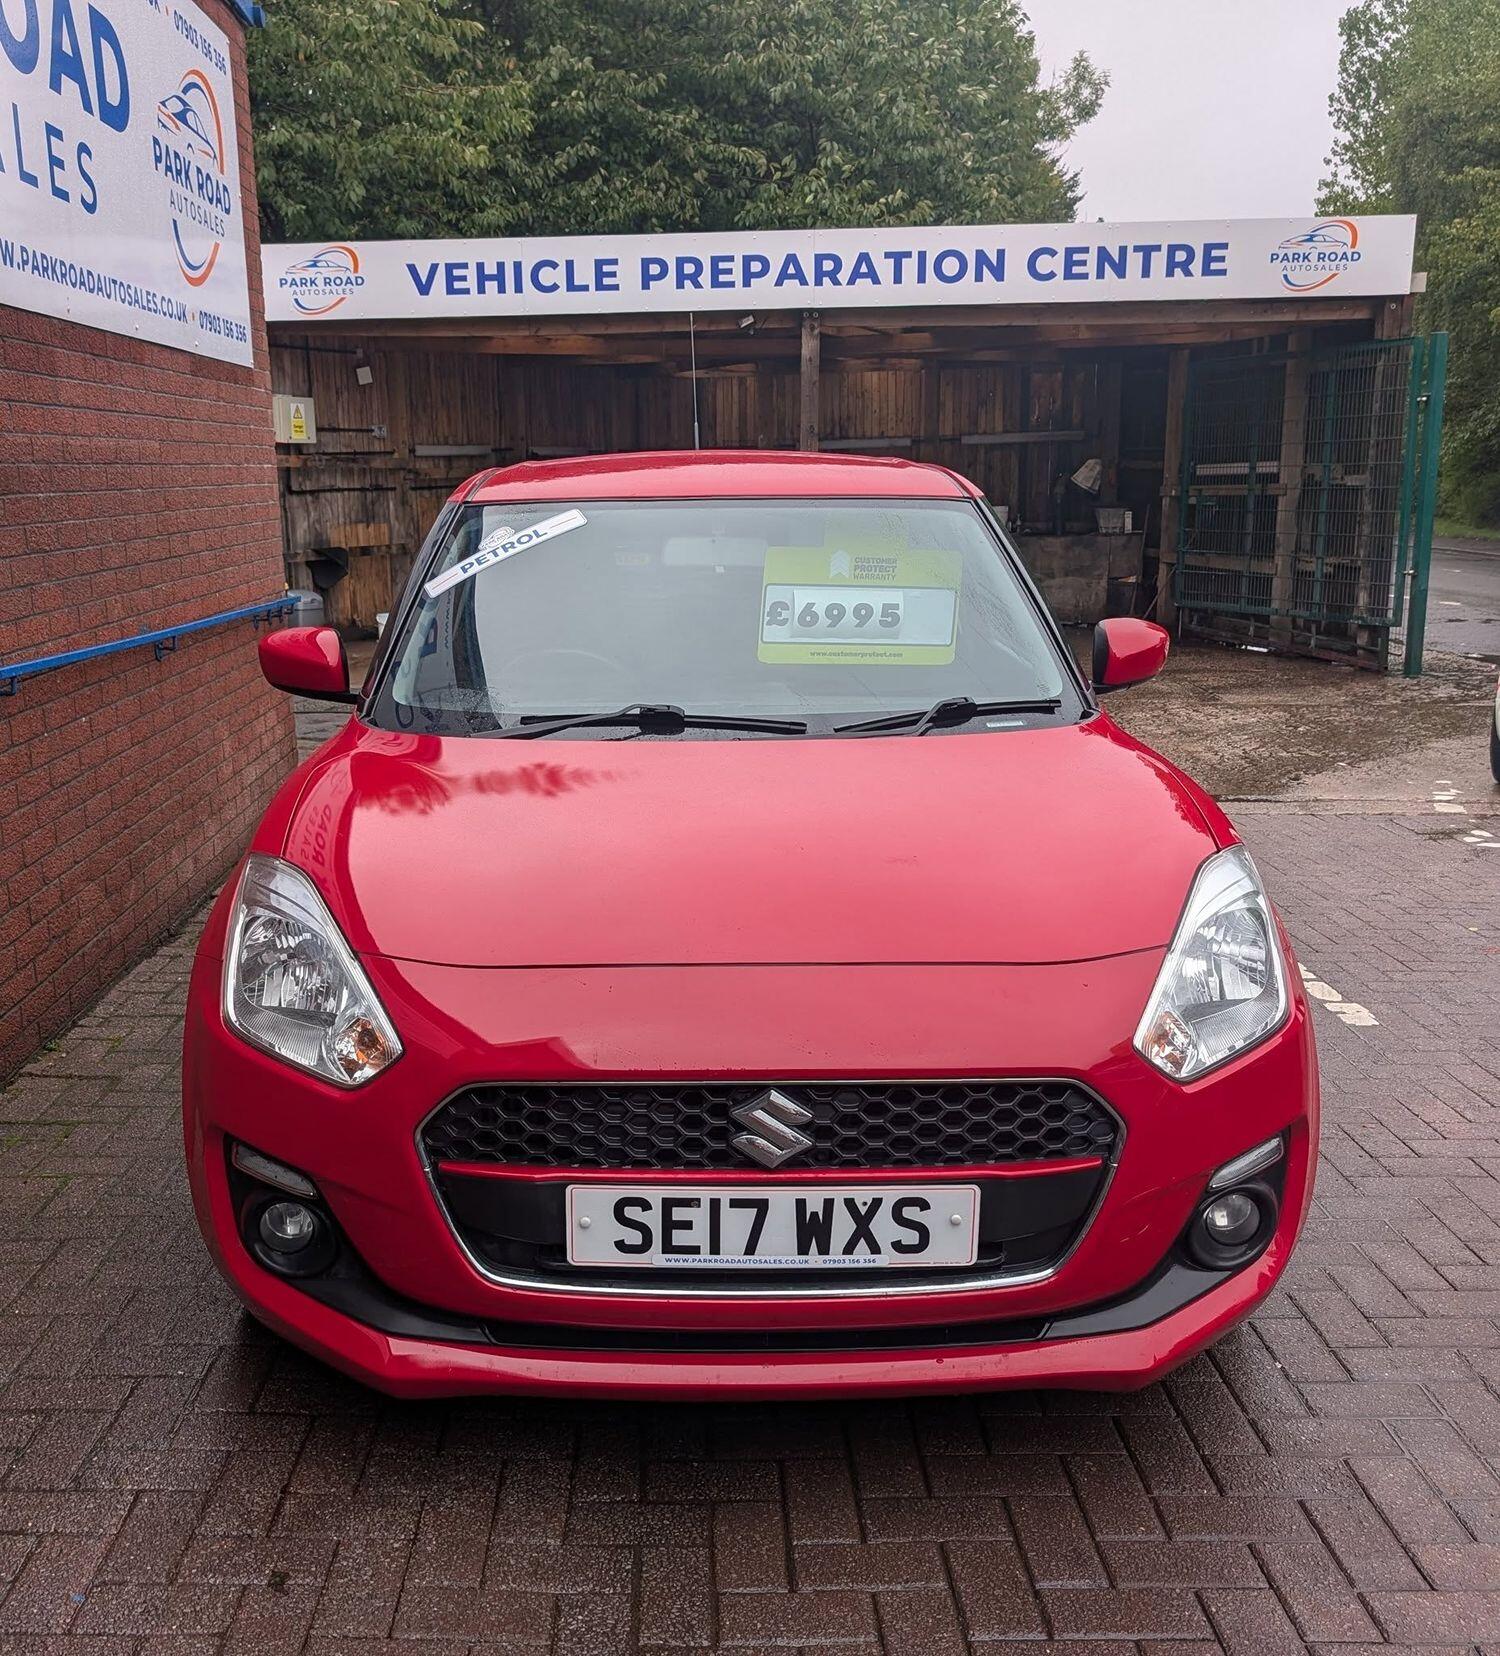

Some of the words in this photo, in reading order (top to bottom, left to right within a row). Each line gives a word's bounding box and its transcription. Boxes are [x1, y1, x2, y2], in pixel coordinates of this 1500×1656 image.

[173, 9, 199, 50] 07903
[199, 33, 213, 63] 156
[213, 47, 227, 76] 356
[0, 102, 98, 215] LES
[152, 134, 194, 194] PARK
[196, 165, 231, 216] ROAD
[170, 188, 225, 238] AUTOSALES
[1269, 251, 1312, 263] PARK
[1317, 251, 1361, 263] ROAD
[405, 257, 620, 297] VEHICLE
[640, 248, 1007, 292] PREPARATION
[1026, 241, 1230, 283] CENTRE
[1281, 263, 1348, 272] AUTOSALES
[279, 277, 319, 288] PARK
[323, 275, 365, 287] ROAD
[291, 288, 354, 296] AUTOSALES
[198, 310, 221, 335] 07903
[222, 318, 234, 340] 156
[235, 322, 248, 344] 356
[460, 529, 548, 575] PETROL
[853, 556, 898, 565] CUSTOMER
[853, 564, 897, 573] PROTECT
[853, 572, 897, 581] WARRANTY
[765, 600, 901, 628] £6995
[809, 650, 904, 659] www.customerprotect.com
[612, 1196, 770, 1256] SE17
[795, 1196, 932, 1256] WXS
[664, 1257, 810, 1265] WWW.PARKROADAUTOSALES.CO.UK
[862, 1257, 877, 1265] 356
